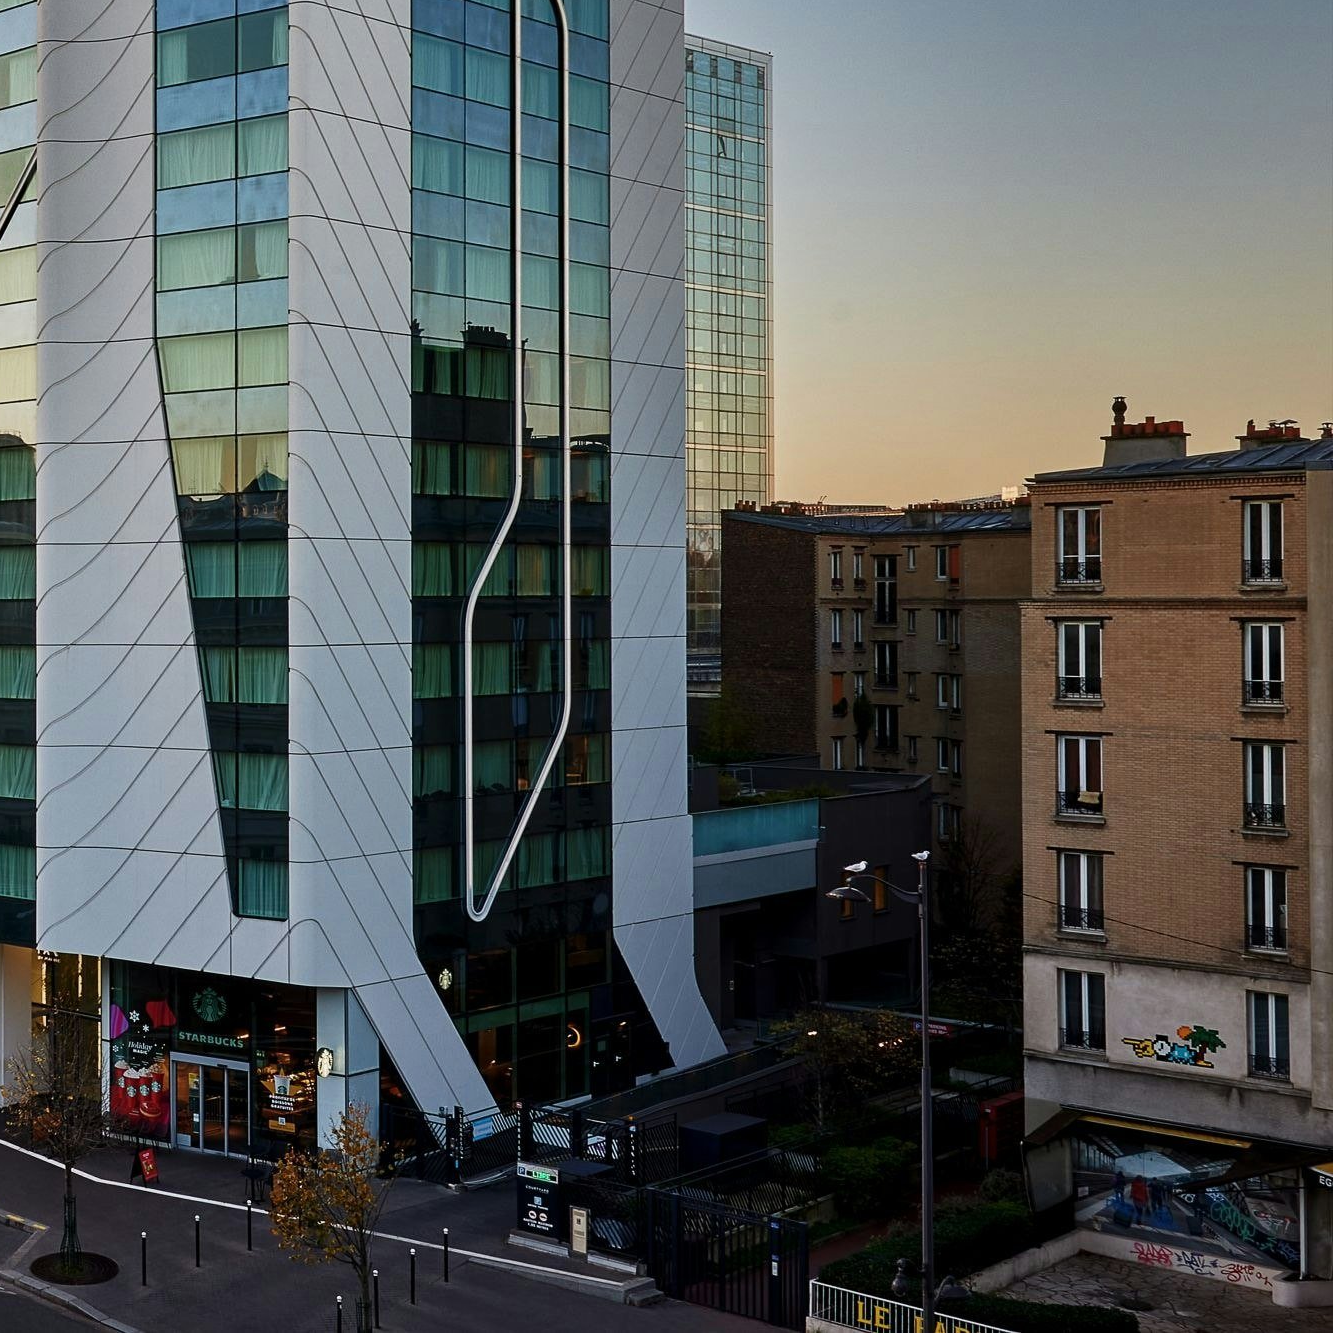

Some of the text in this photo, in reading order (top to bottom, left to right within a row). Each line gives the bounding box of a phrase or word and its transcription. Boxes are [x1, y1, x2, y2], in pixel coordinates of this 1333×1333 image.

[128, 1041, 152, 1051] Holiday
[178, 1031, 244, 1048] STARBUCKS
[857, 1300, 891, 1329] LE
